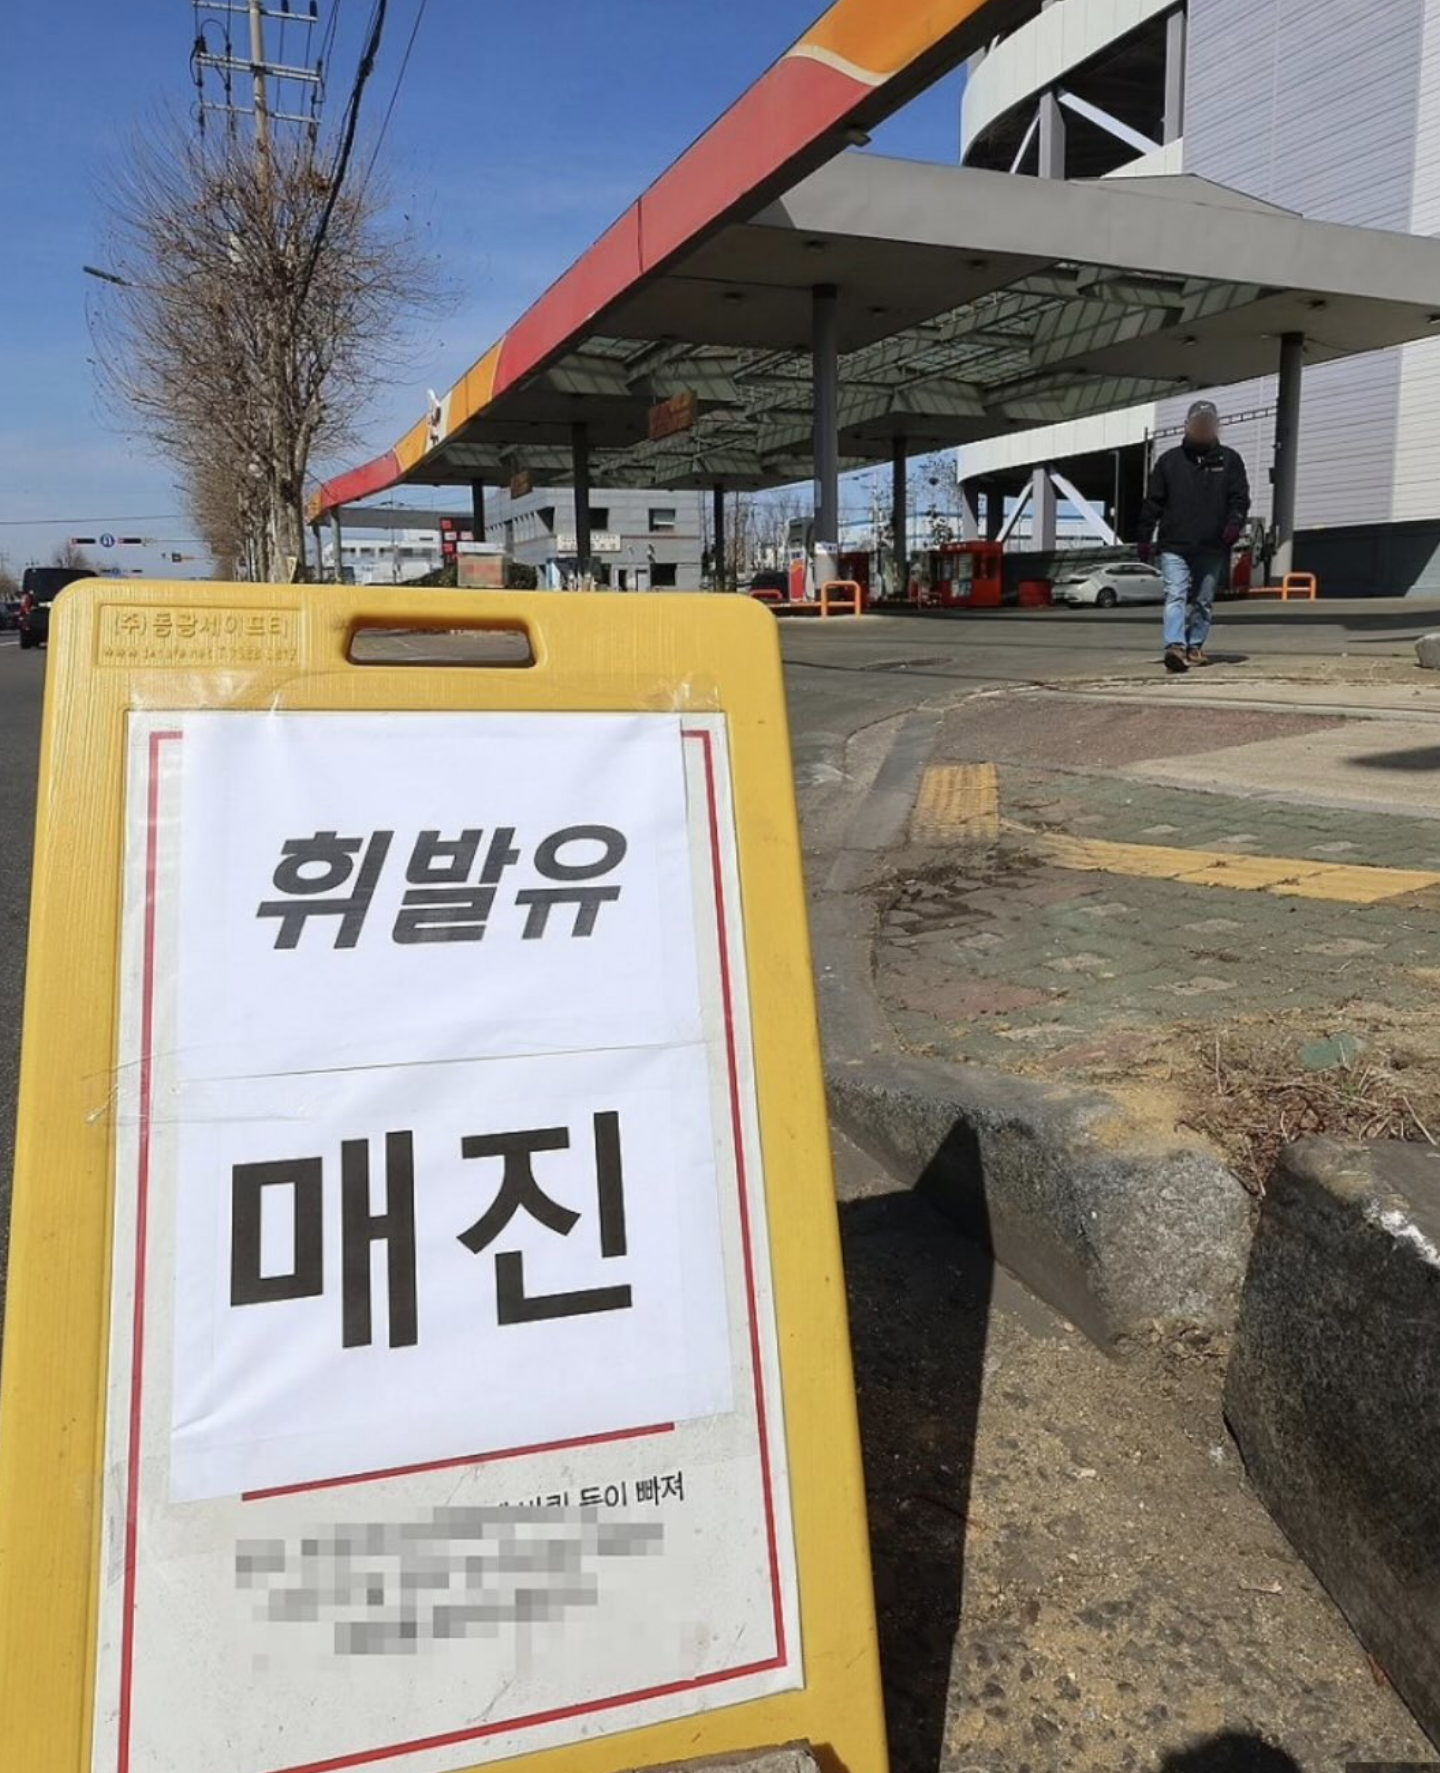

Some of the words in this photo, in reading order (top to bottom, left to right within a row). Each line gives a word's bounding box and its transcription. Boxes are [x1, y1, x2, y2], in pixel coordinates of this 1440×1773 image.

[256, 824, 627, 950] 휘발유
[230, 1110, 633, 1349] 매진
[635, 1470, 685, 1507] 빠져
